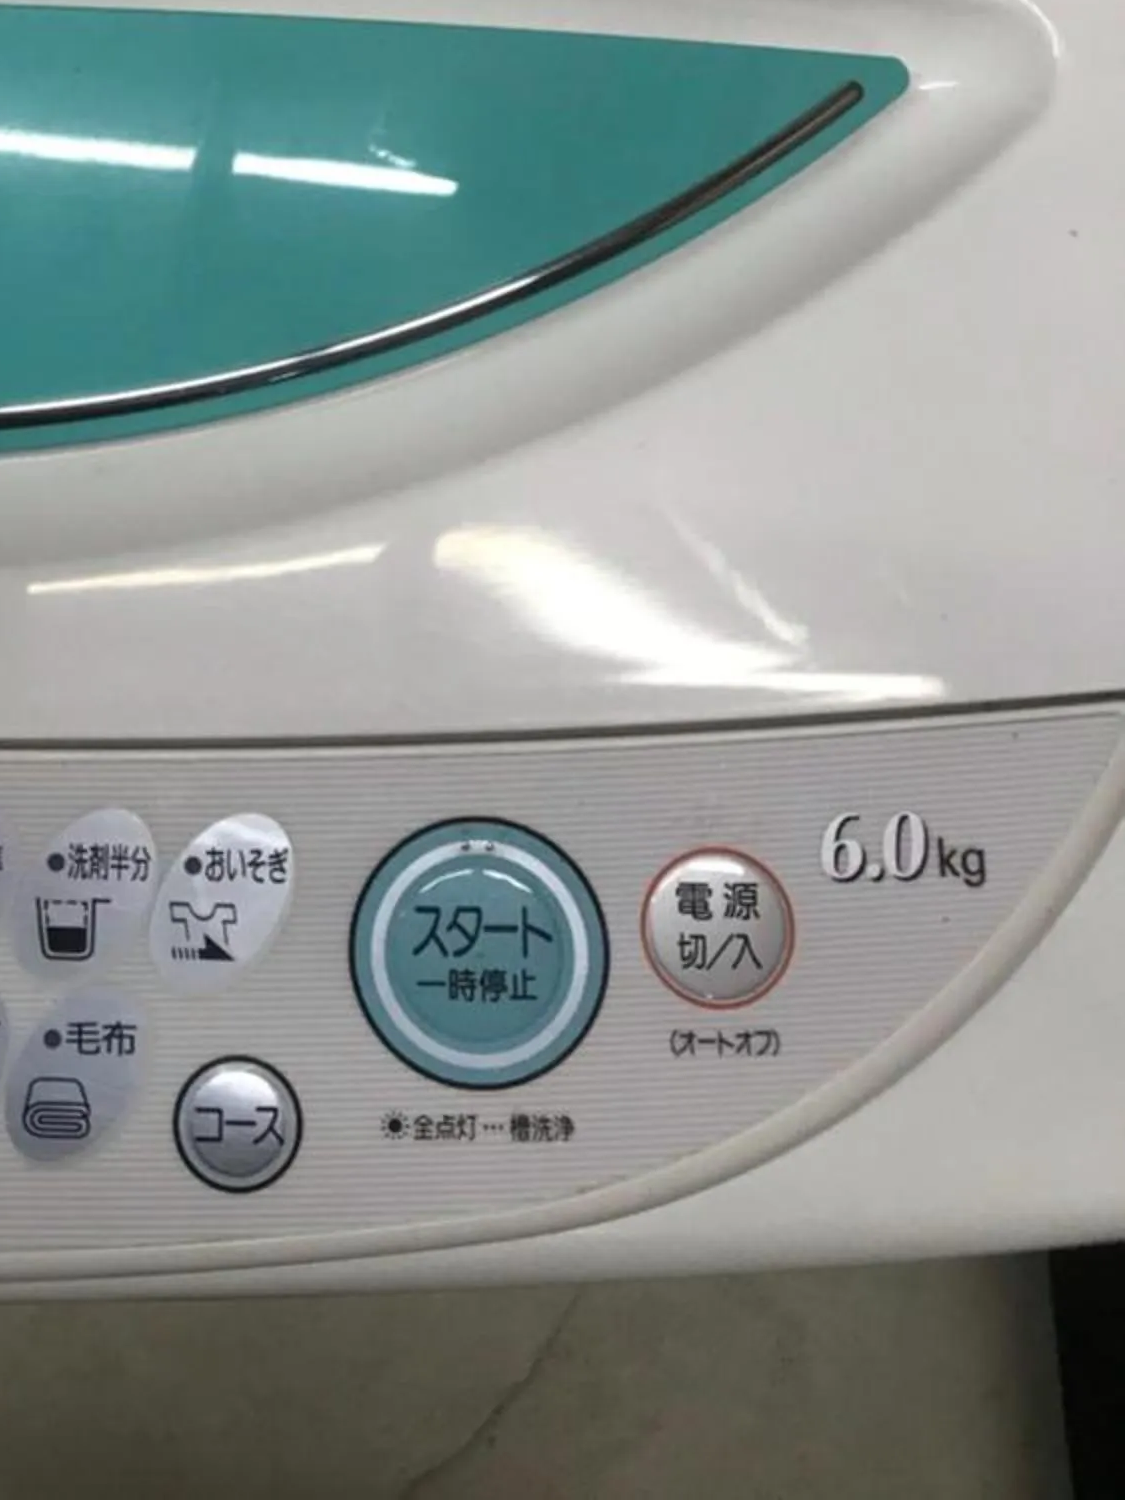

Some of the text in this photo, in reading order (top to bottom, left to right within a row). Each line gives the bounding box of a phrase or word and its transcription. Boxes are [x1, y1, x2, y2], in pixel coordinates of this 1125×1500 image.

[68, 843, 152, 882] 洗剤半分
[204, 846, 290, 884] おいそぎ
[675, 881, 761, 922] 電源
[412, 905, 554, 958] スタート
[416, 969, 537, 1002] 一時停止
[65, 1020, 138, 1057] 毛布
[194, 1105, 286, 1147] コース
